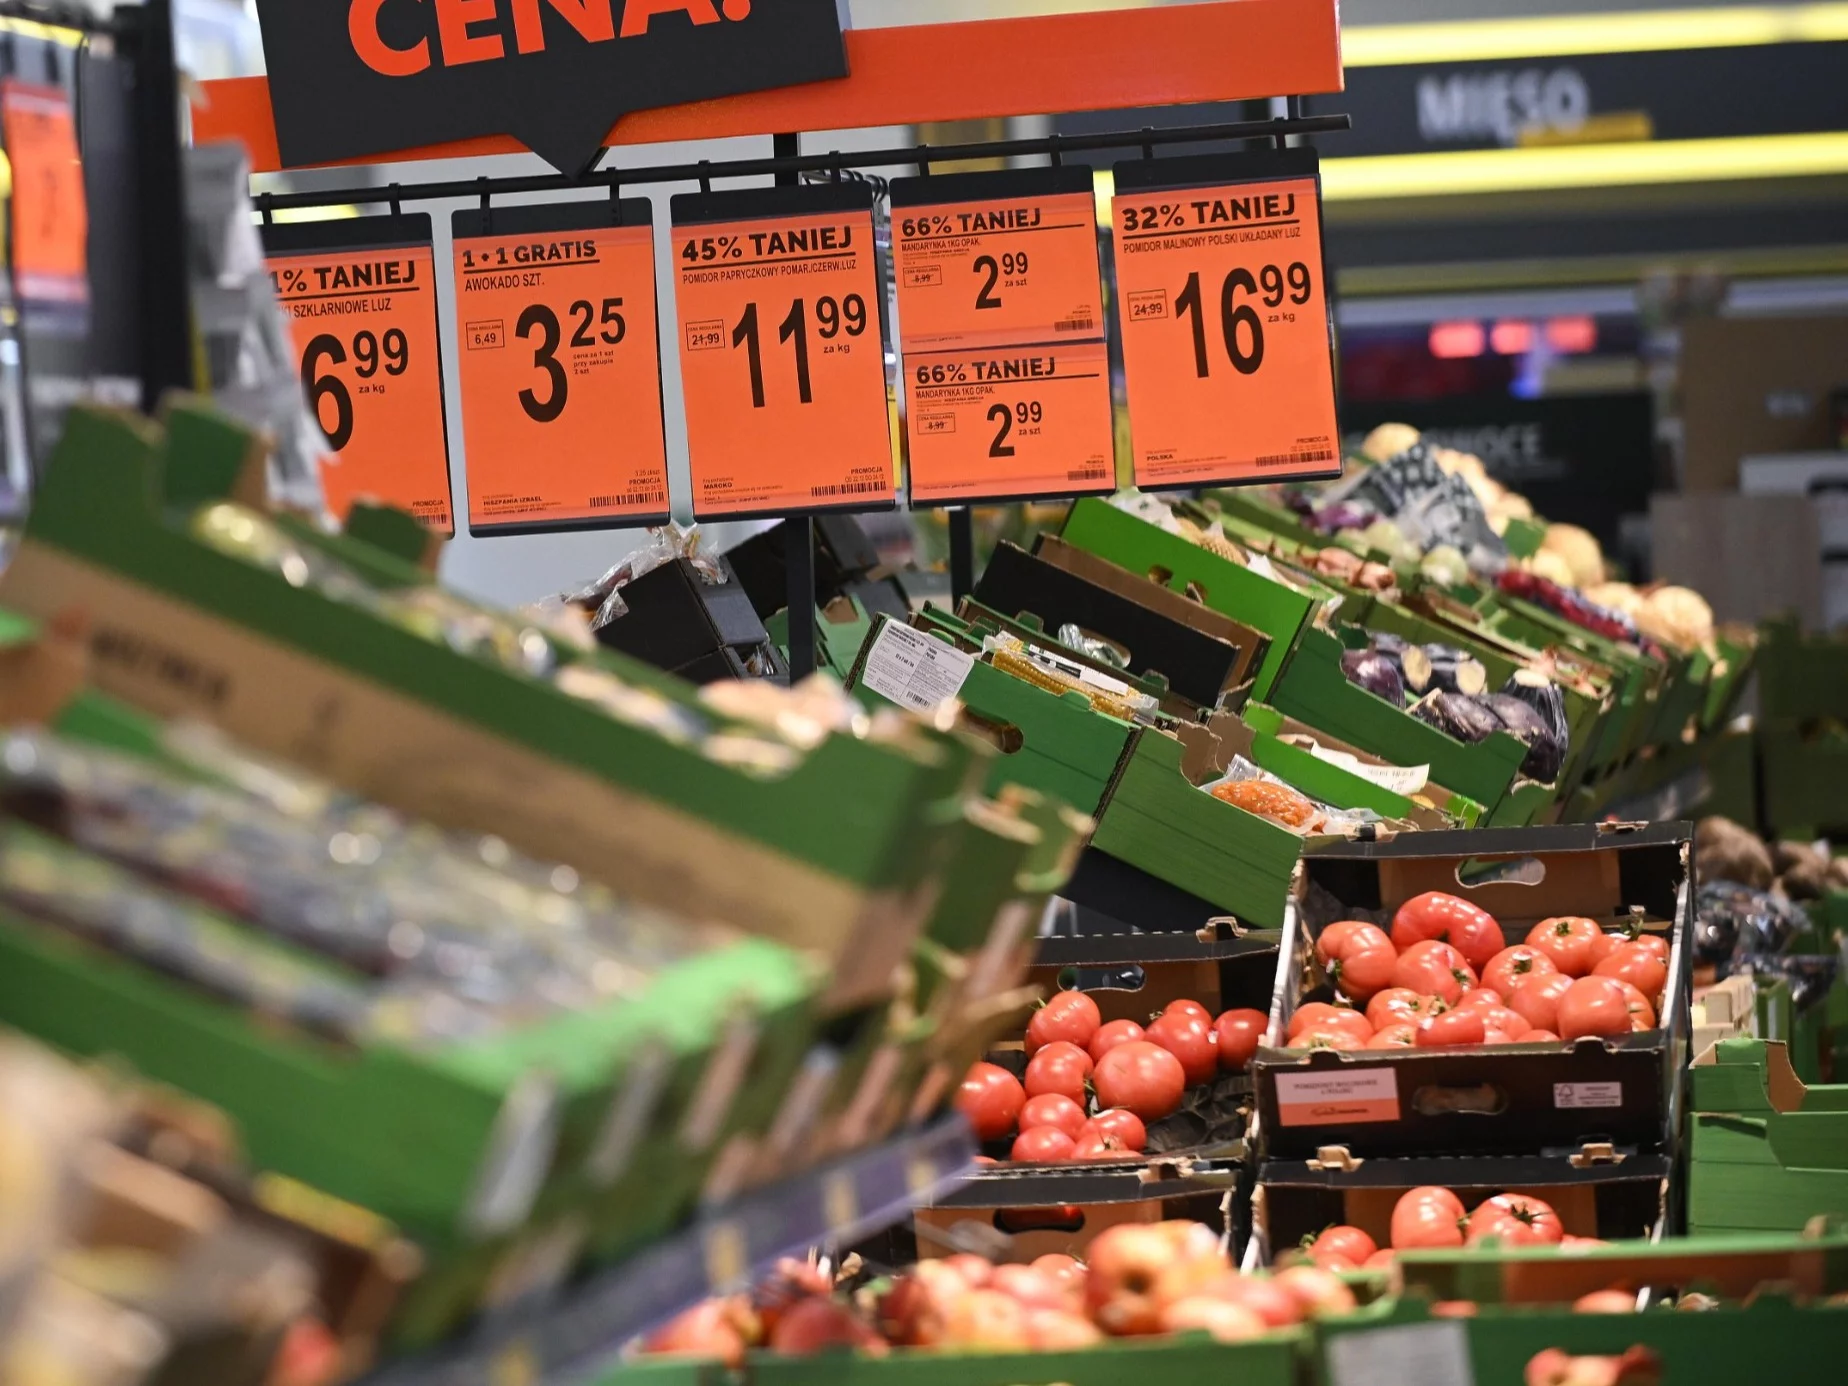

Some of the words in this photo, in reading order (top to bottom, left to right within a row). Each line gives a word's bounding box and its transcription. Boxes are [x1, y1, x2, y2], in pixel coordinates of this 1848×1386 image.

[348, 0, 751, 77] CEN
[902, 216, 952, 237] 66%
[956, 208, 1041, 232] TANIEJ
[1122, 204, 1185, 232] 32%
[1191, 193, 1295, 224] TANIEJ
[682, 236, 743, 262] 45%
[748, 226, 852, 256] TANIEJ
[901, 240, 946, 252] MANDARYNKA
[947, 239, 960, 248] 1KG
[1123, 241, 1162, 254] POMIDOR
[1163, 236, 1206, 251] MALINOWY
[1208, 234, 1238, 248] POLSKI
[1239, 228, 1283, 243] UKŁADANY
[1285, 227, 1301, 238] LUZ
[462, 250, 475, 267] 1
[495, 247, 508, 265] 1
[513, 240, 597, 263] GRATIS
[313, 260, 416, 290] TANIEJ
[464, 274, 520, 292] AWOKADO
[522, 272, 545, 287] SZT.
[683, 272, 719, 284] POMIDOR
[720, 266, 779, 281] PAPRYCZKOWY
[973, 255, 1002, 310] 2
[1002, 252, 1029, 275] 99
[1015, 278, 1027, 286] szt
[294, 300, 369, 318] SZKLARNIOWE
[371, 298, 392, 312] LUZ
[1134, 302, 1162, 316] 24,99
[1268, 314, 1279, 322] za
[1282, 312, 1295, 323] kg
[1175, 267, 1264, 378] 16
[1260, 261, 1311, 308] 99
[475, 332, 496, 346] 6,49
[692, 332, 720, 346] 21,99
[837, 343, 850, 353] kg
[515, 304, 568, 423] 3
[569, 297, 626, 348] 25
[732, 298, 812, 408] 11
[815, 293, 867, 339] 99
[916, 363, 967, 384] 66%
[971, 357, 1056, 380] TANIEJ
[301, 333, 353, 452] 6
[353, 328, 409, 379] 99
[372, 383, 385, 394] kg
[915, 388, 961, 399] MANDARYNKA
[962, 387, 975, 395] 1KG
[975, 386, 995, 394] OPAK.
[986, 403, 1015, 458] 2
[1016, 401, 1042, 424] 99
[1018, 428, 1028, 436] za
[1029, 426, 1041, 435] szt
[1146, 453, 1174, 461] POLSKA
[850, 466, 883, 474] PROMOCJA
[628, 476, 661, 485] PROMOCJA
[703, 482, 733, 490] MAROKO
